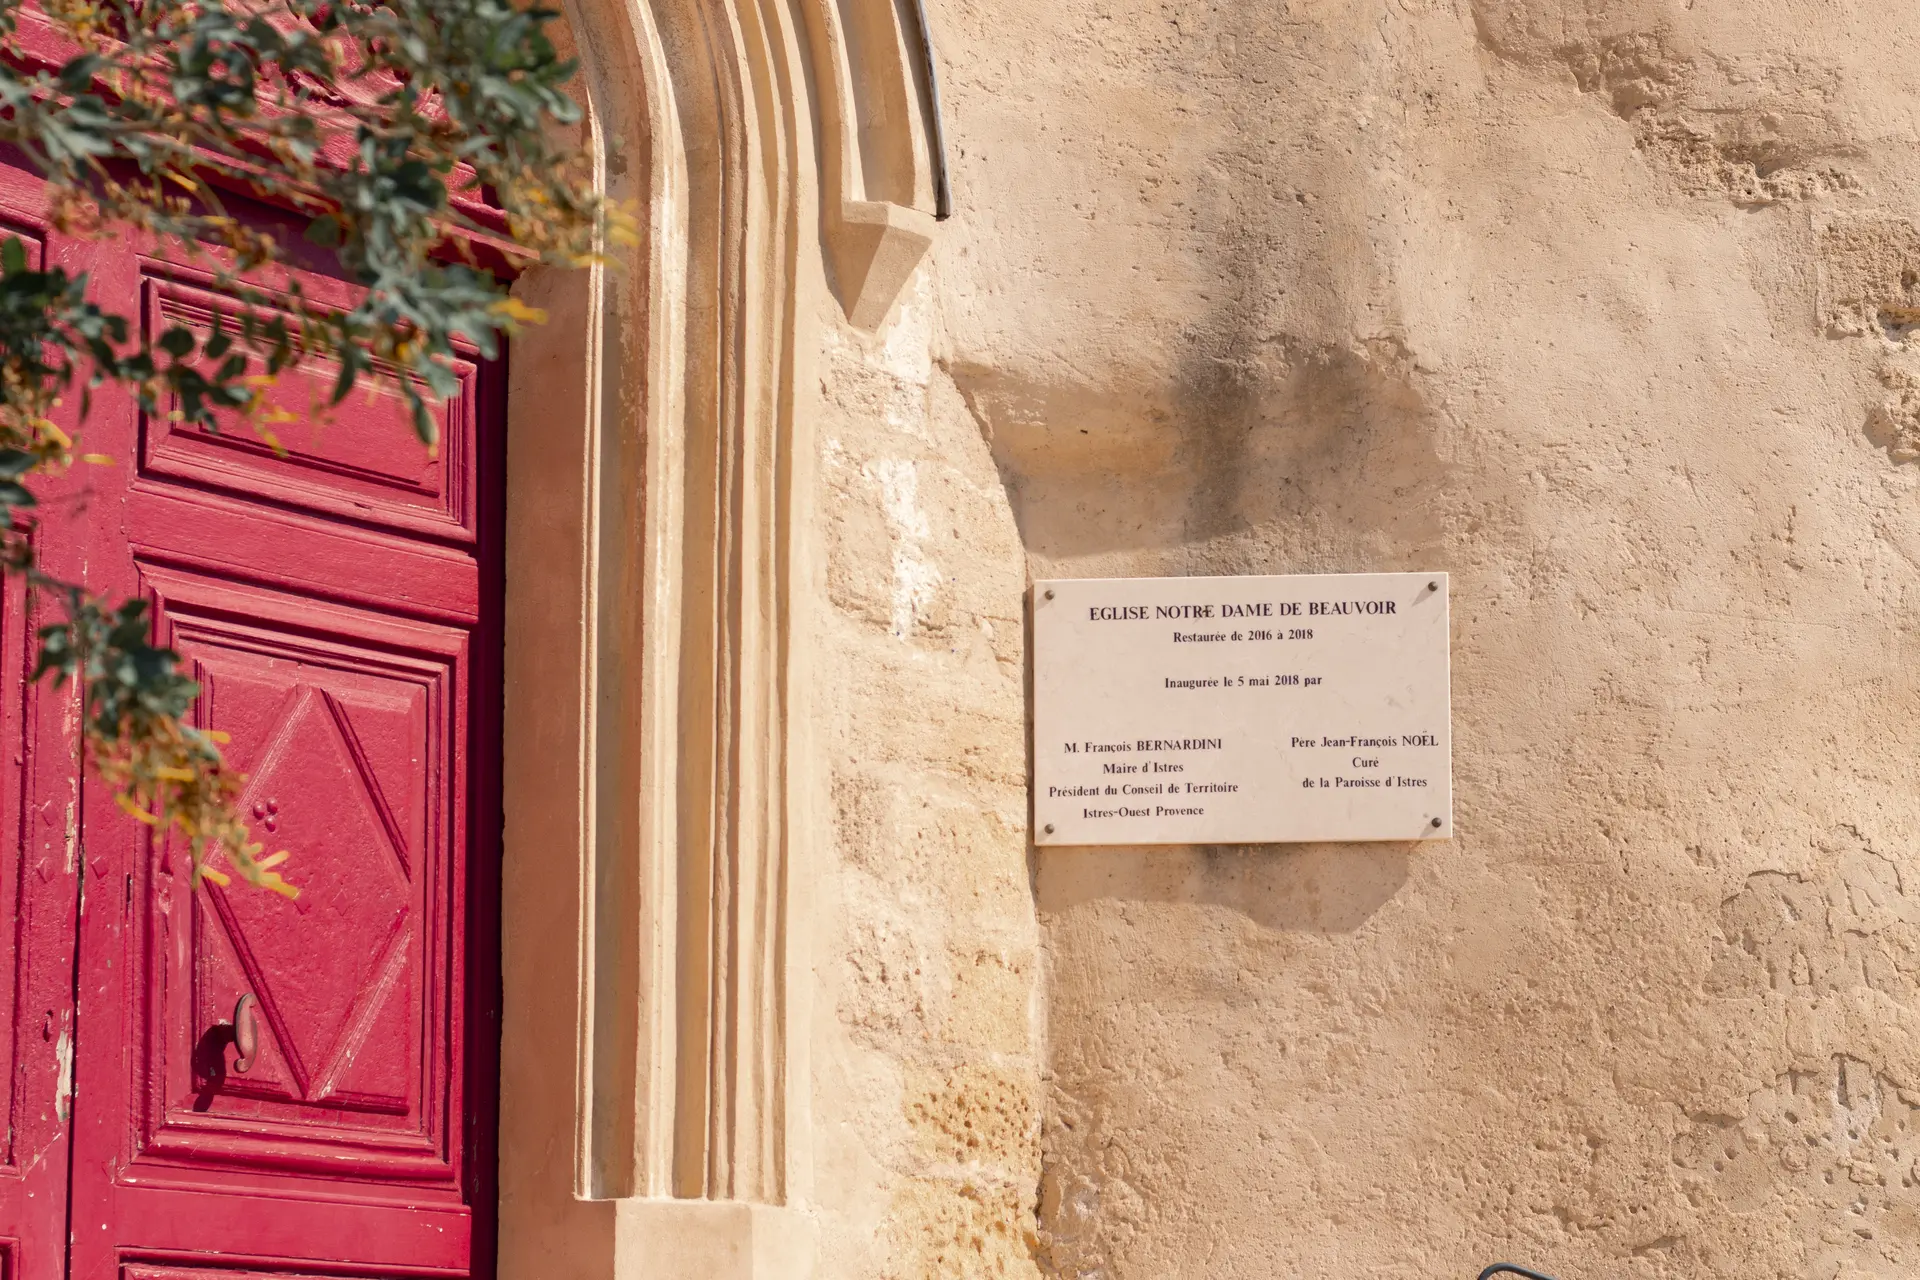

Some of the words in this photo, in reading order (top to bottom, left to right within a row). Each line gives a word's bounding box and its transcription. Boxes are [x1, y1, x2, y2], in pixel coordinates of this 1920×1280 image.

[1089, 605, 1150, 621] EGLISE
[1155, 604, 1215, 620] NOTRE
[1221, 602, 1273, 618] DAME
[1279, 601, 1303, 617] DE
[1308, 600, 1397, 616] BEAUVOIR
[1173, 631, 1227, 643] Restaurée
[1230, 630, 1244, 642] de
[1247, 629, 1273, 641] 2016
[1276, 629, 1284, 641] à
[1288, 628, 1314, 641] 2018
[1164, 676, 1219, 691] Inaugurée
[1223, 676, 1234, 688] le
[1237, 675, 1245, 687] 5
[1248, 675, 1270, 687] mai
[1274, 674, 1300, 686] 2018
[1303, 676, 1323, 688] par
[1064, 742, 1080, 754] M.
[1084, 740, 1132, 754] François
[1136, 738, 1222, 752] BERNARDINI
[1291, 736, 1317, 748] Père
[1320, 735, 1398, 749] Jean-François
[1401, 730, 1439, 747] NOËL
[1102, 762, 1138, 775] Maire
[1351, 756, 1380, 769] Curé
[1048, 785, 1100, 798] Président
[1104, 784, 1118, 796] du
[1121, 783, 1163, 796] Conseil
[1167, 782, 1181, 794] de
[1184, 781, 1239, 794] Territoire
[1302, 777, 1315, 789] de
[1319, 776, 1330, 788] la
[1334, 776, 1381, 788] Paroisse
[1083, 806, 1151, 819] Istres-Ouest
[1155, 805, 1205, 817] Provence
